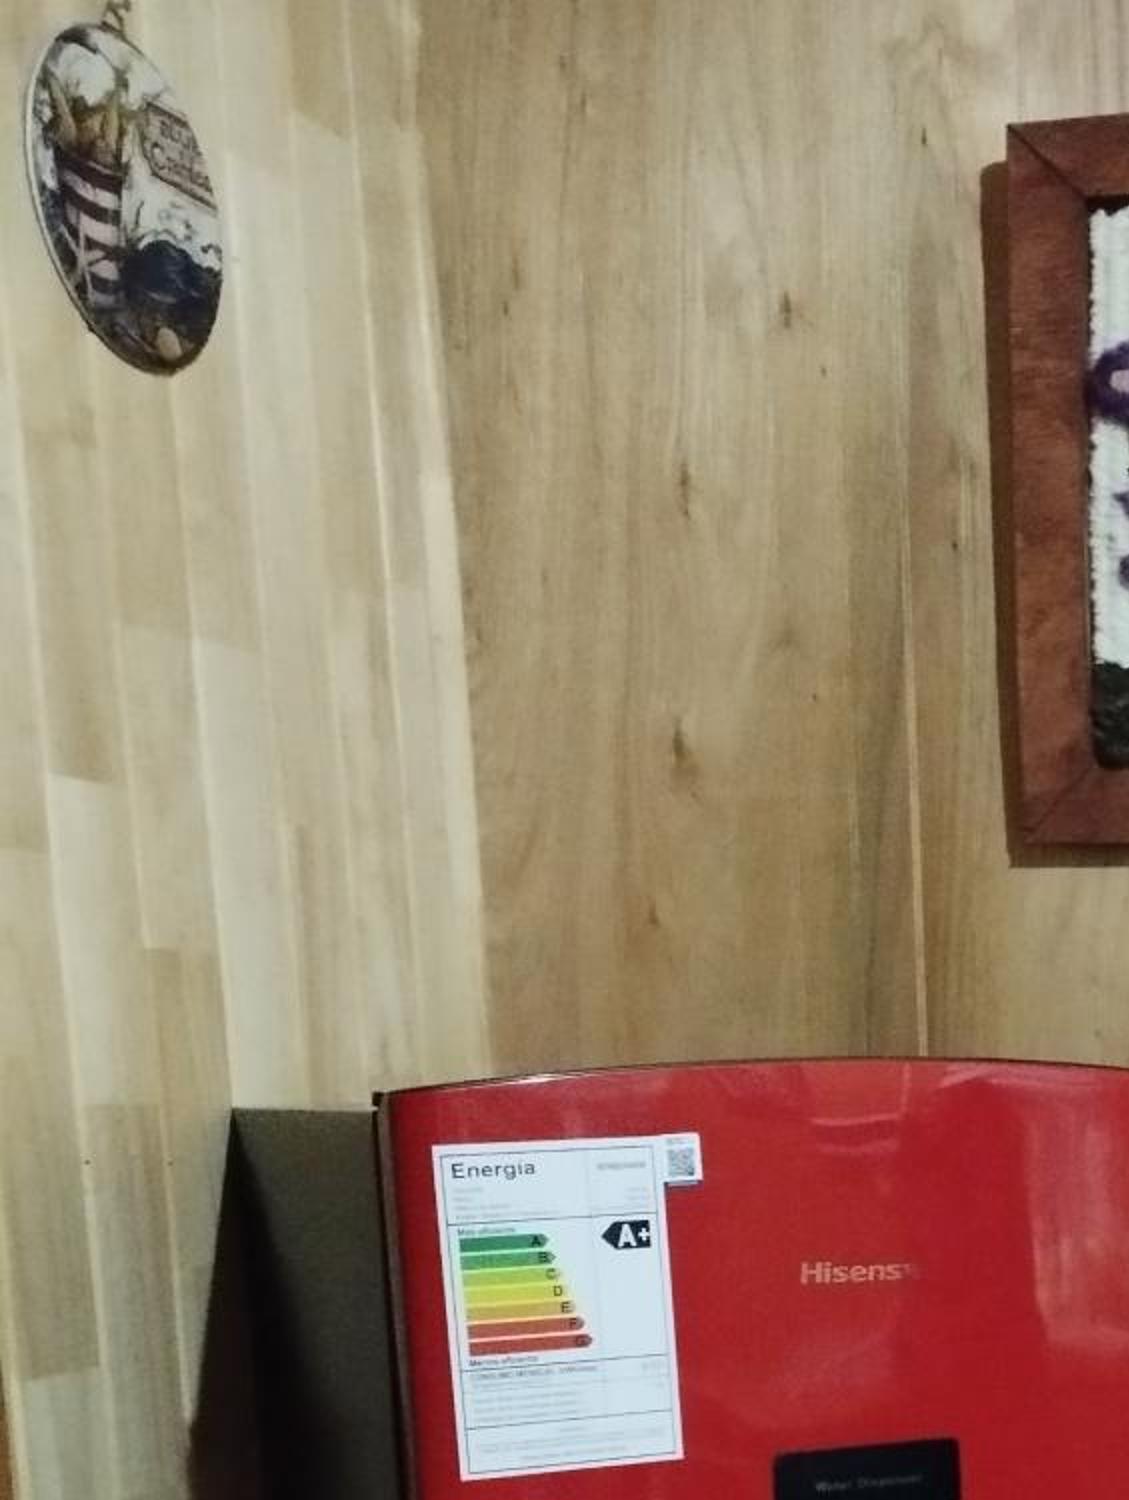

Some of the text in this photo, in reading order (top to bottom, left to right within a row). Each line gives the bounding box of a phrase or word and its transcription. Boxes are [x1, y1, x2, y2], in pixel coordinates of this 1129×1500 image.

[530, 1235, 541, 1247] A
[617, 1223, 650, 1248] A+
[538, 1252, 549, 1264] B
[545, 1268, 557, 1281] C
[553, 1285, 563, 1297] D
[560, 1301, 571, 1314] E
[569, 1317, 578, 1329] F
